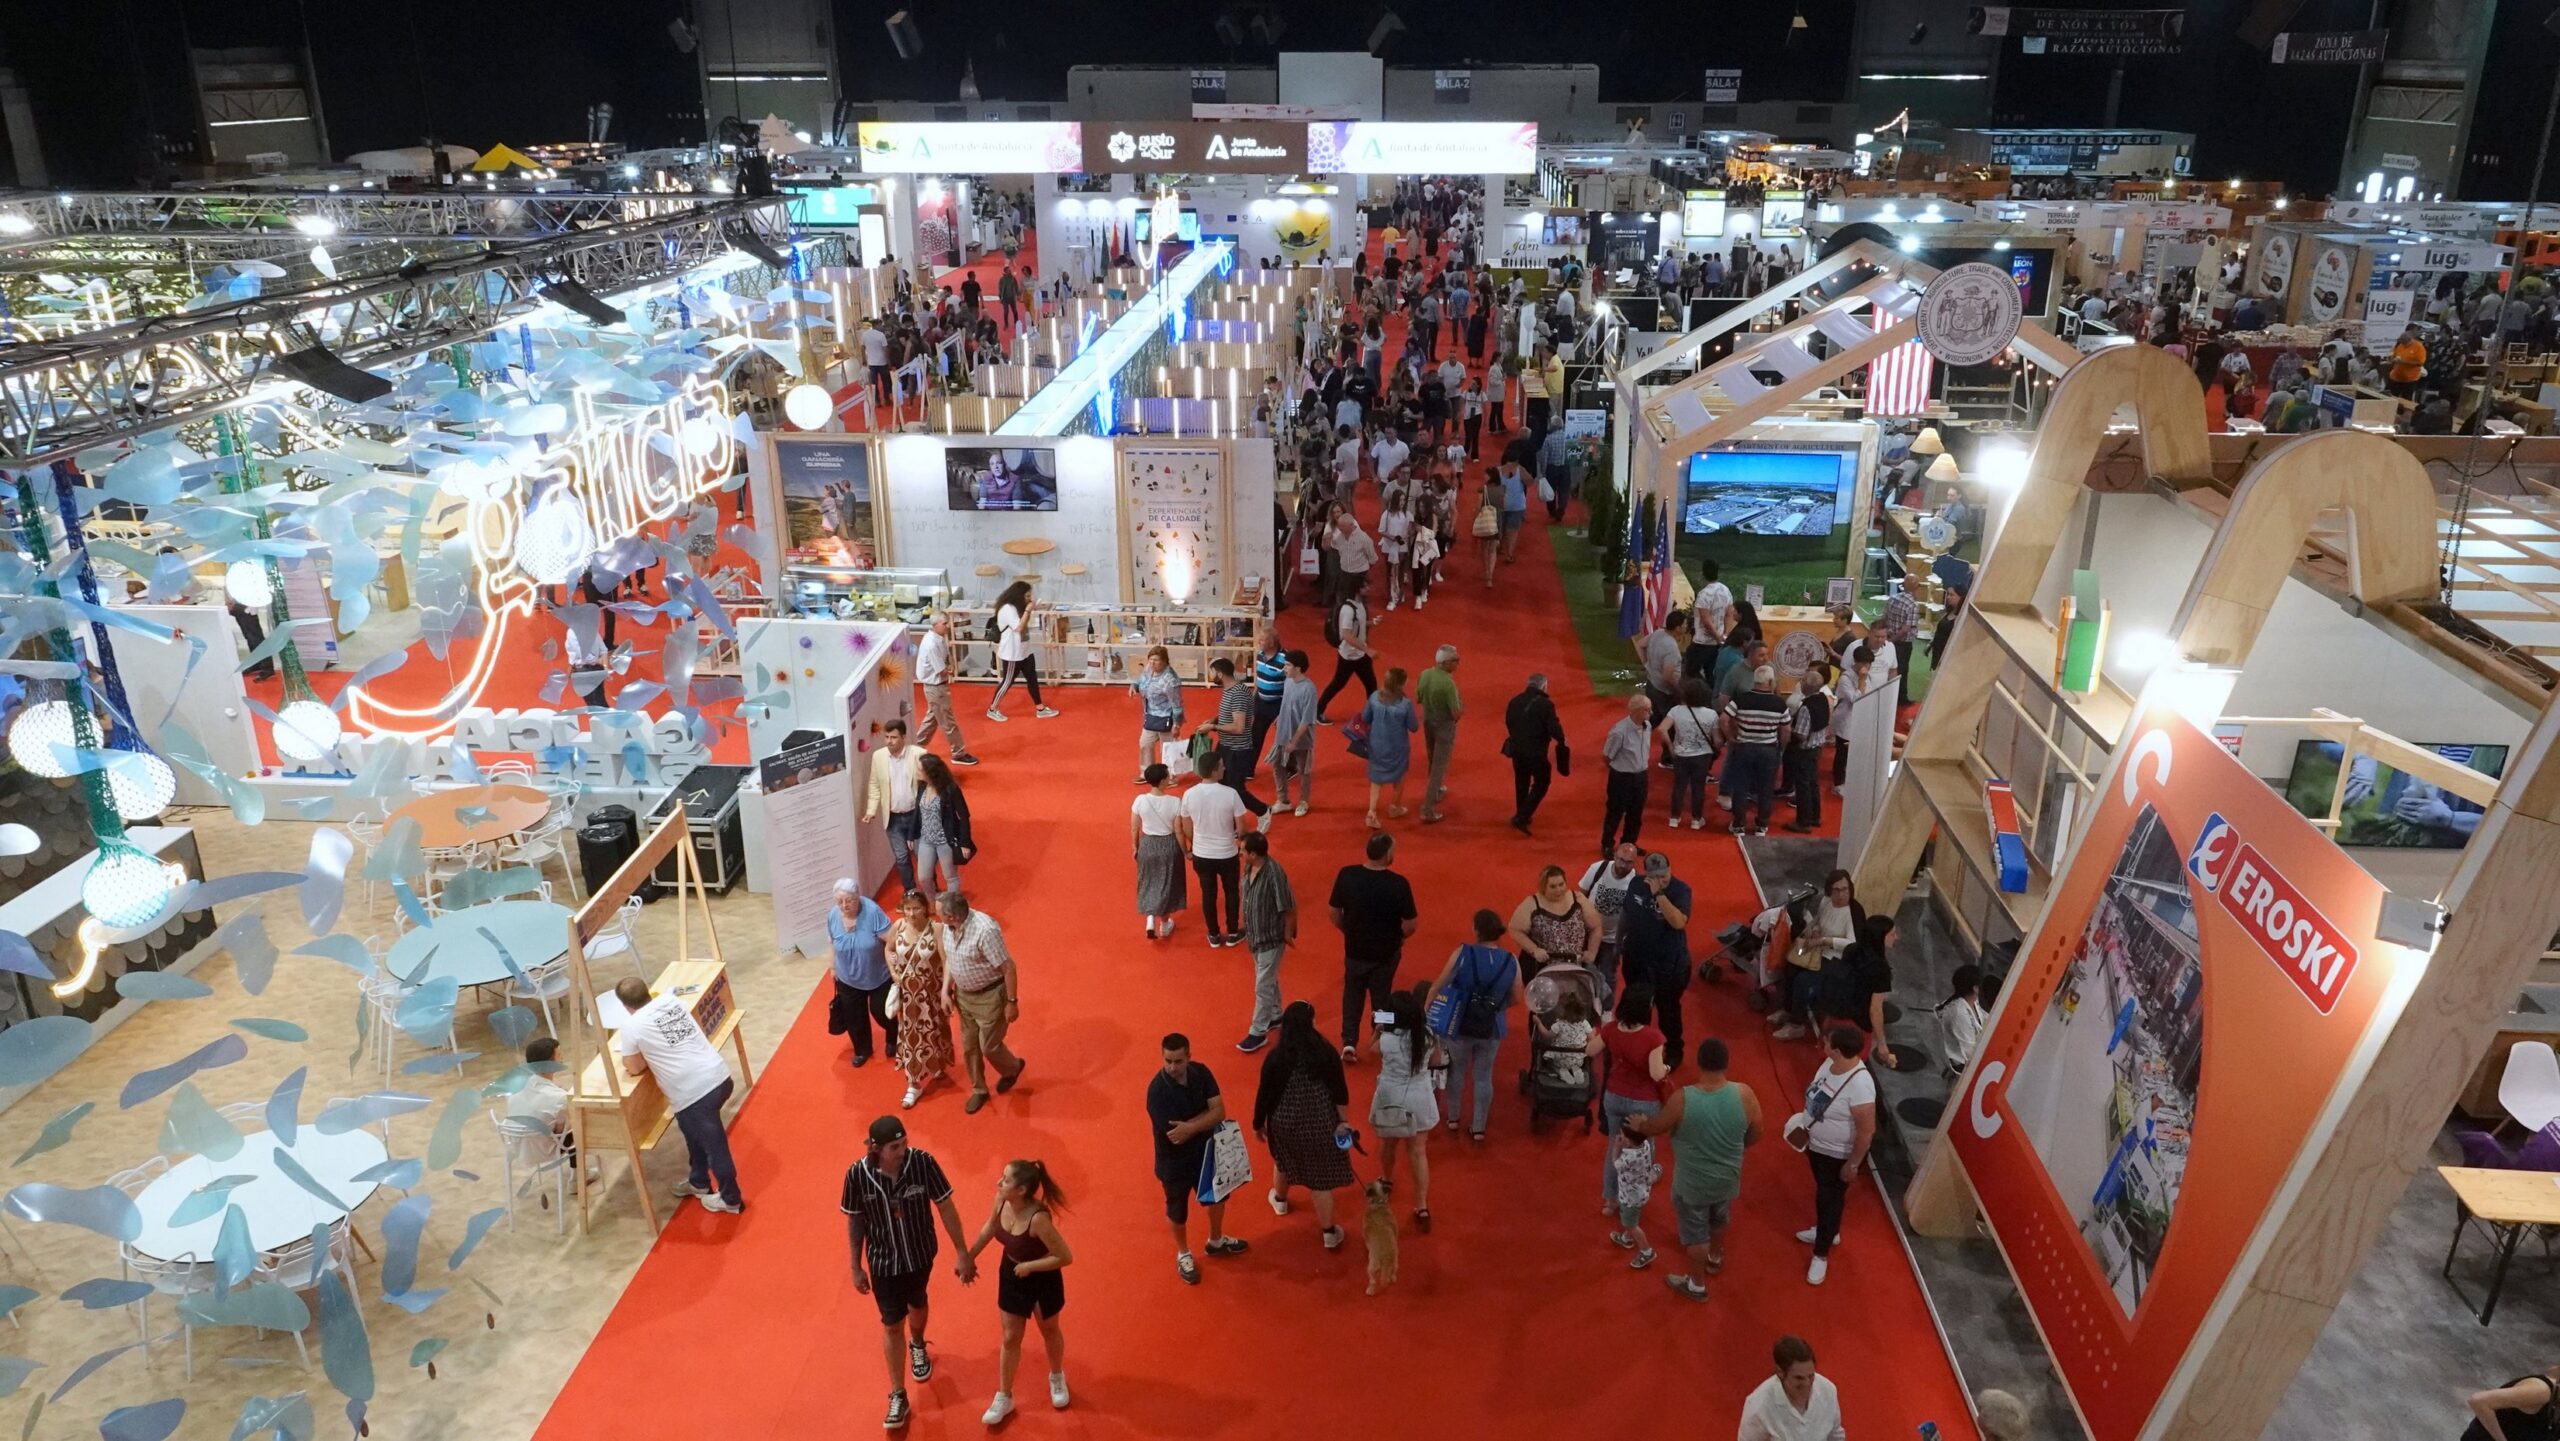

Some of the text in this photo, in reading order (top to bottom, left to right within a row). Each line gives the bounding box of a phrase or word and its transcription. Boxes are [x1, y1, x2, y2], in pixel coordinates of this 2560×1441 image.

[2341, 36, 2354, 48] DE
[2052, 44, 2092, 54] RAZAS
[1138, 133, 1175, 151] gusto
[1231, 137, 1257, 148] Junta
[1150, 146, 1175, 160] Sur
[1231, 146, 1287, 157] de Andalucía
[1919, 309, 1938, 351] DEPARTMENT
[1968, 265, 1992, 276] TRADE
[1944, 352, 1984, 363] WISCONSIN
[1148, 507, 1202, 515] EXPERIENCIAS
[2229, 860, 2345, 995] EROSKI
